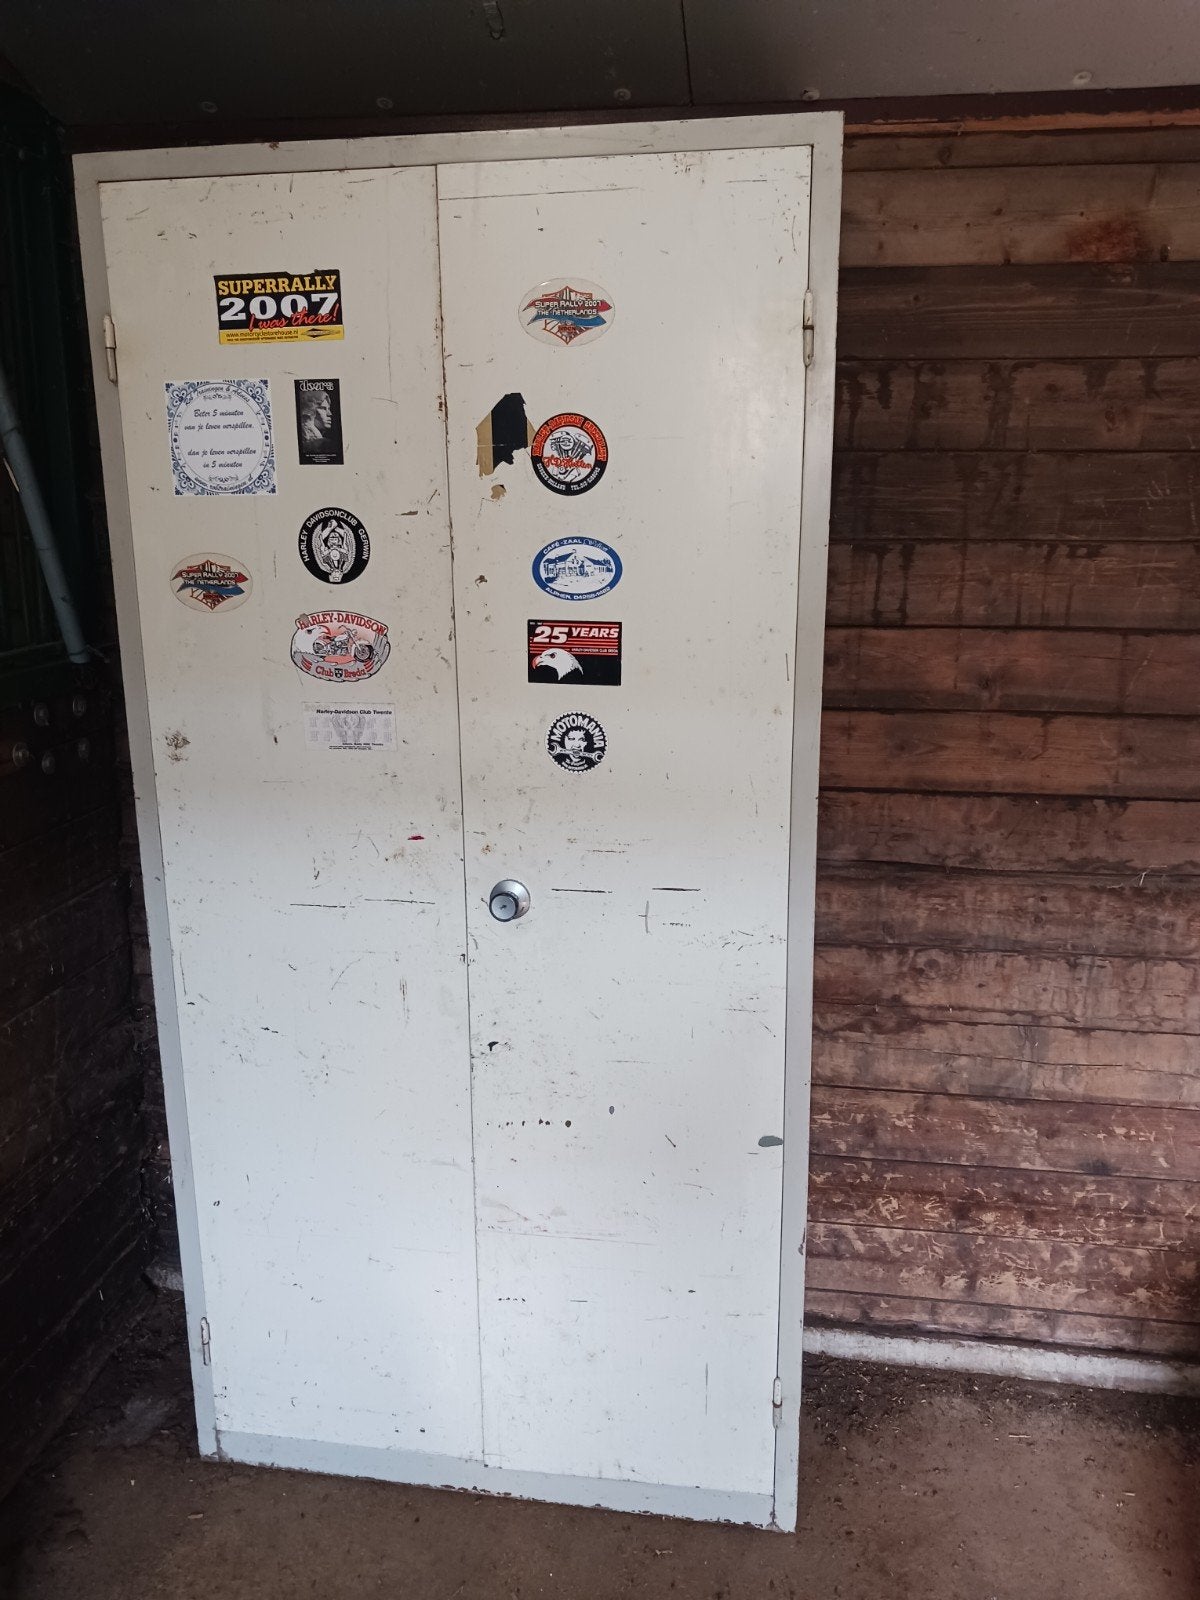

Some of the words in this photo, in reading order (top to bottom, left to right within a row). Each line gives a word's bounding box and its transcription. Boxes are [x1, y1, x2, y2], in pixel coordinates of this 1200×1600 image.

[218, 275, 337, 296] SUPERRALLY
[219, 292, 339, 321] 2007
[258, 316, 289, 329] was
[290, 303, 340, 325] there!
[193, 409, 211, 418] Beter
[212, 409, 218, 417] 5
[197, 424, 204, 432] je
[202, 450, 208, 458] je
[209, 448, 225, 456] leven
[226, 447, 257, 459] verspillen
[211, 460, 217, 468] 5
[300, 529, 310, 563] HARLEY
[305, 509, 359, 528] DAVIDSONCLUB
[358, 528, 370, 561] GERWIN
[533, 625, 569, 644] 25
[571, 627, 619, 638] YEARS
[315, 665, 334, 677] Club
[344, 669, 367, 678] Breda
[550, 715, 605, 749] MOTOMANIA
